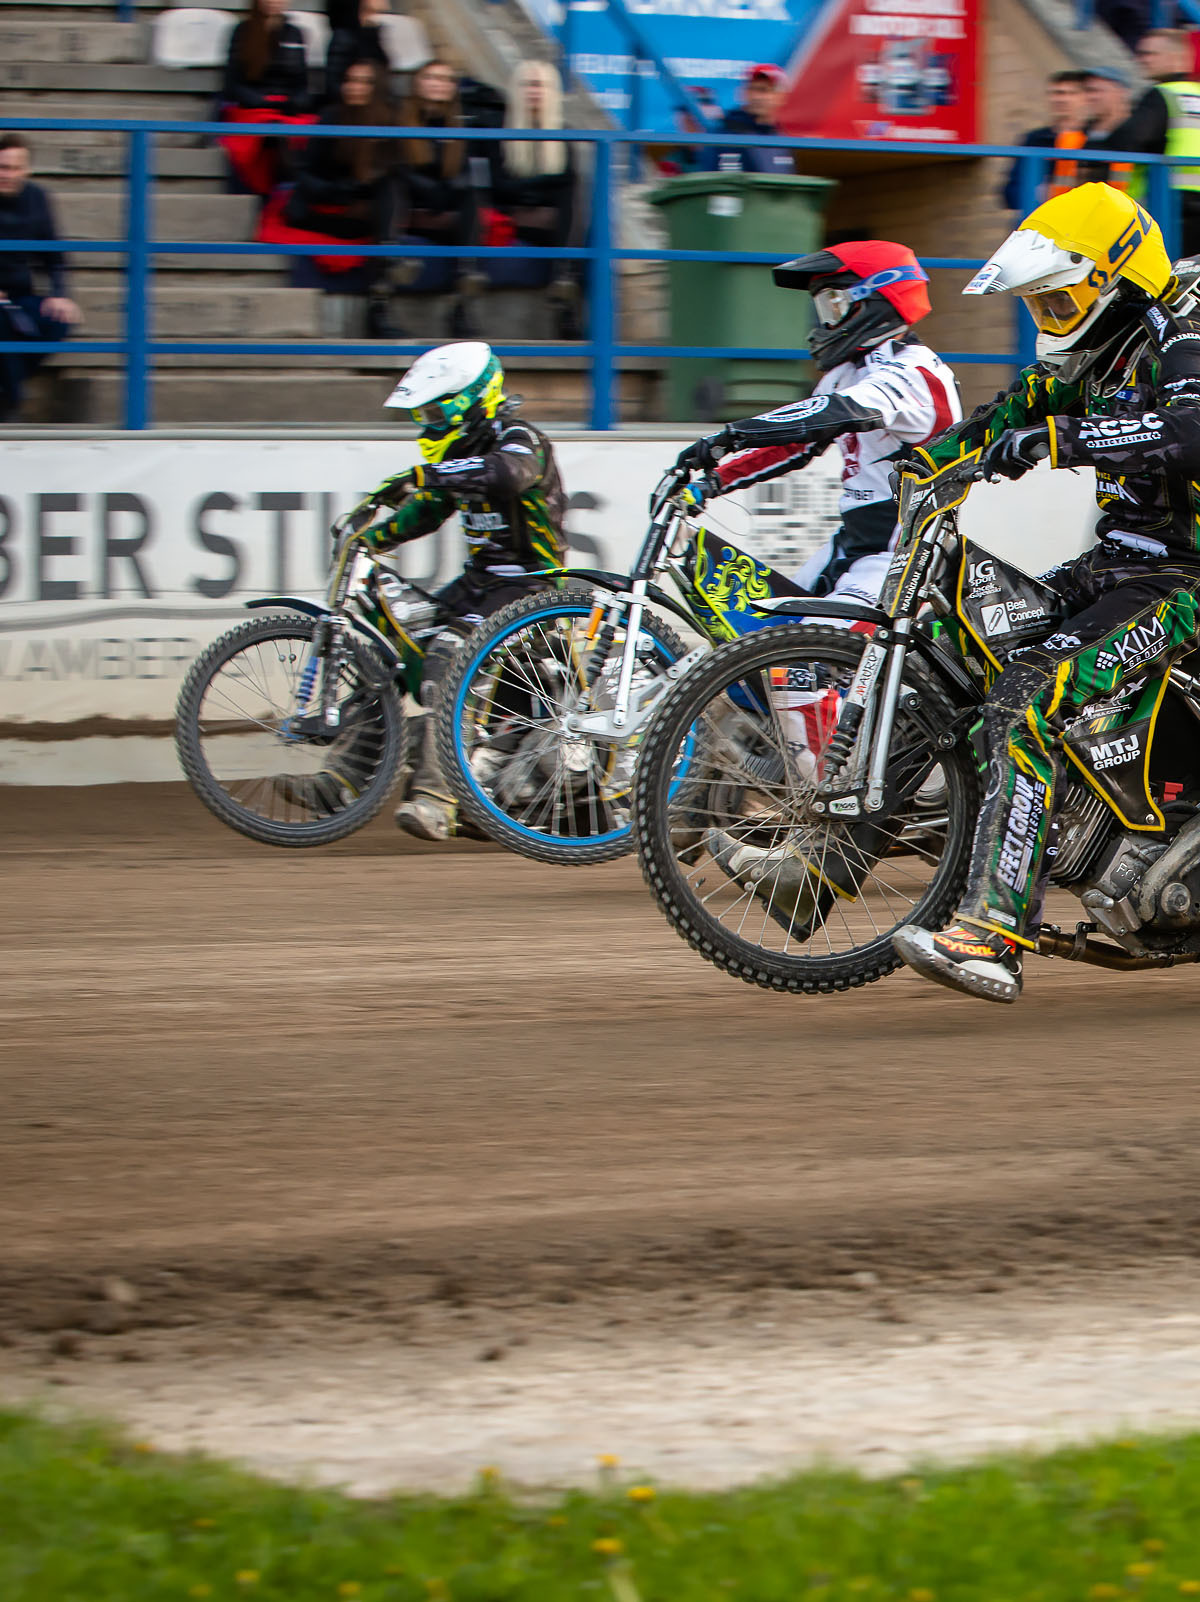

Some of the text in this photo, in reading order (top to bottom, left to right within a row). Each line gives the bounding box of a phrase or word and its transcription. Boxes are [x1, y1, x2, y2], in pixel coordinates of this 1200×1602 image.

[1078, 412, 1165, 439] ACDC
[1098, 433, 1149, 446] RECYCLING
[1005, 599, 1027, 611] Best
[1009, 606, 1045, 622] Concept
[1113, 616, 1167, 661] KIM
[1128, 641, 1164, 667] GROUP
[1089, 734, 1140, 761] MTJ
[1093, 749, 1141, 771] GROUP
